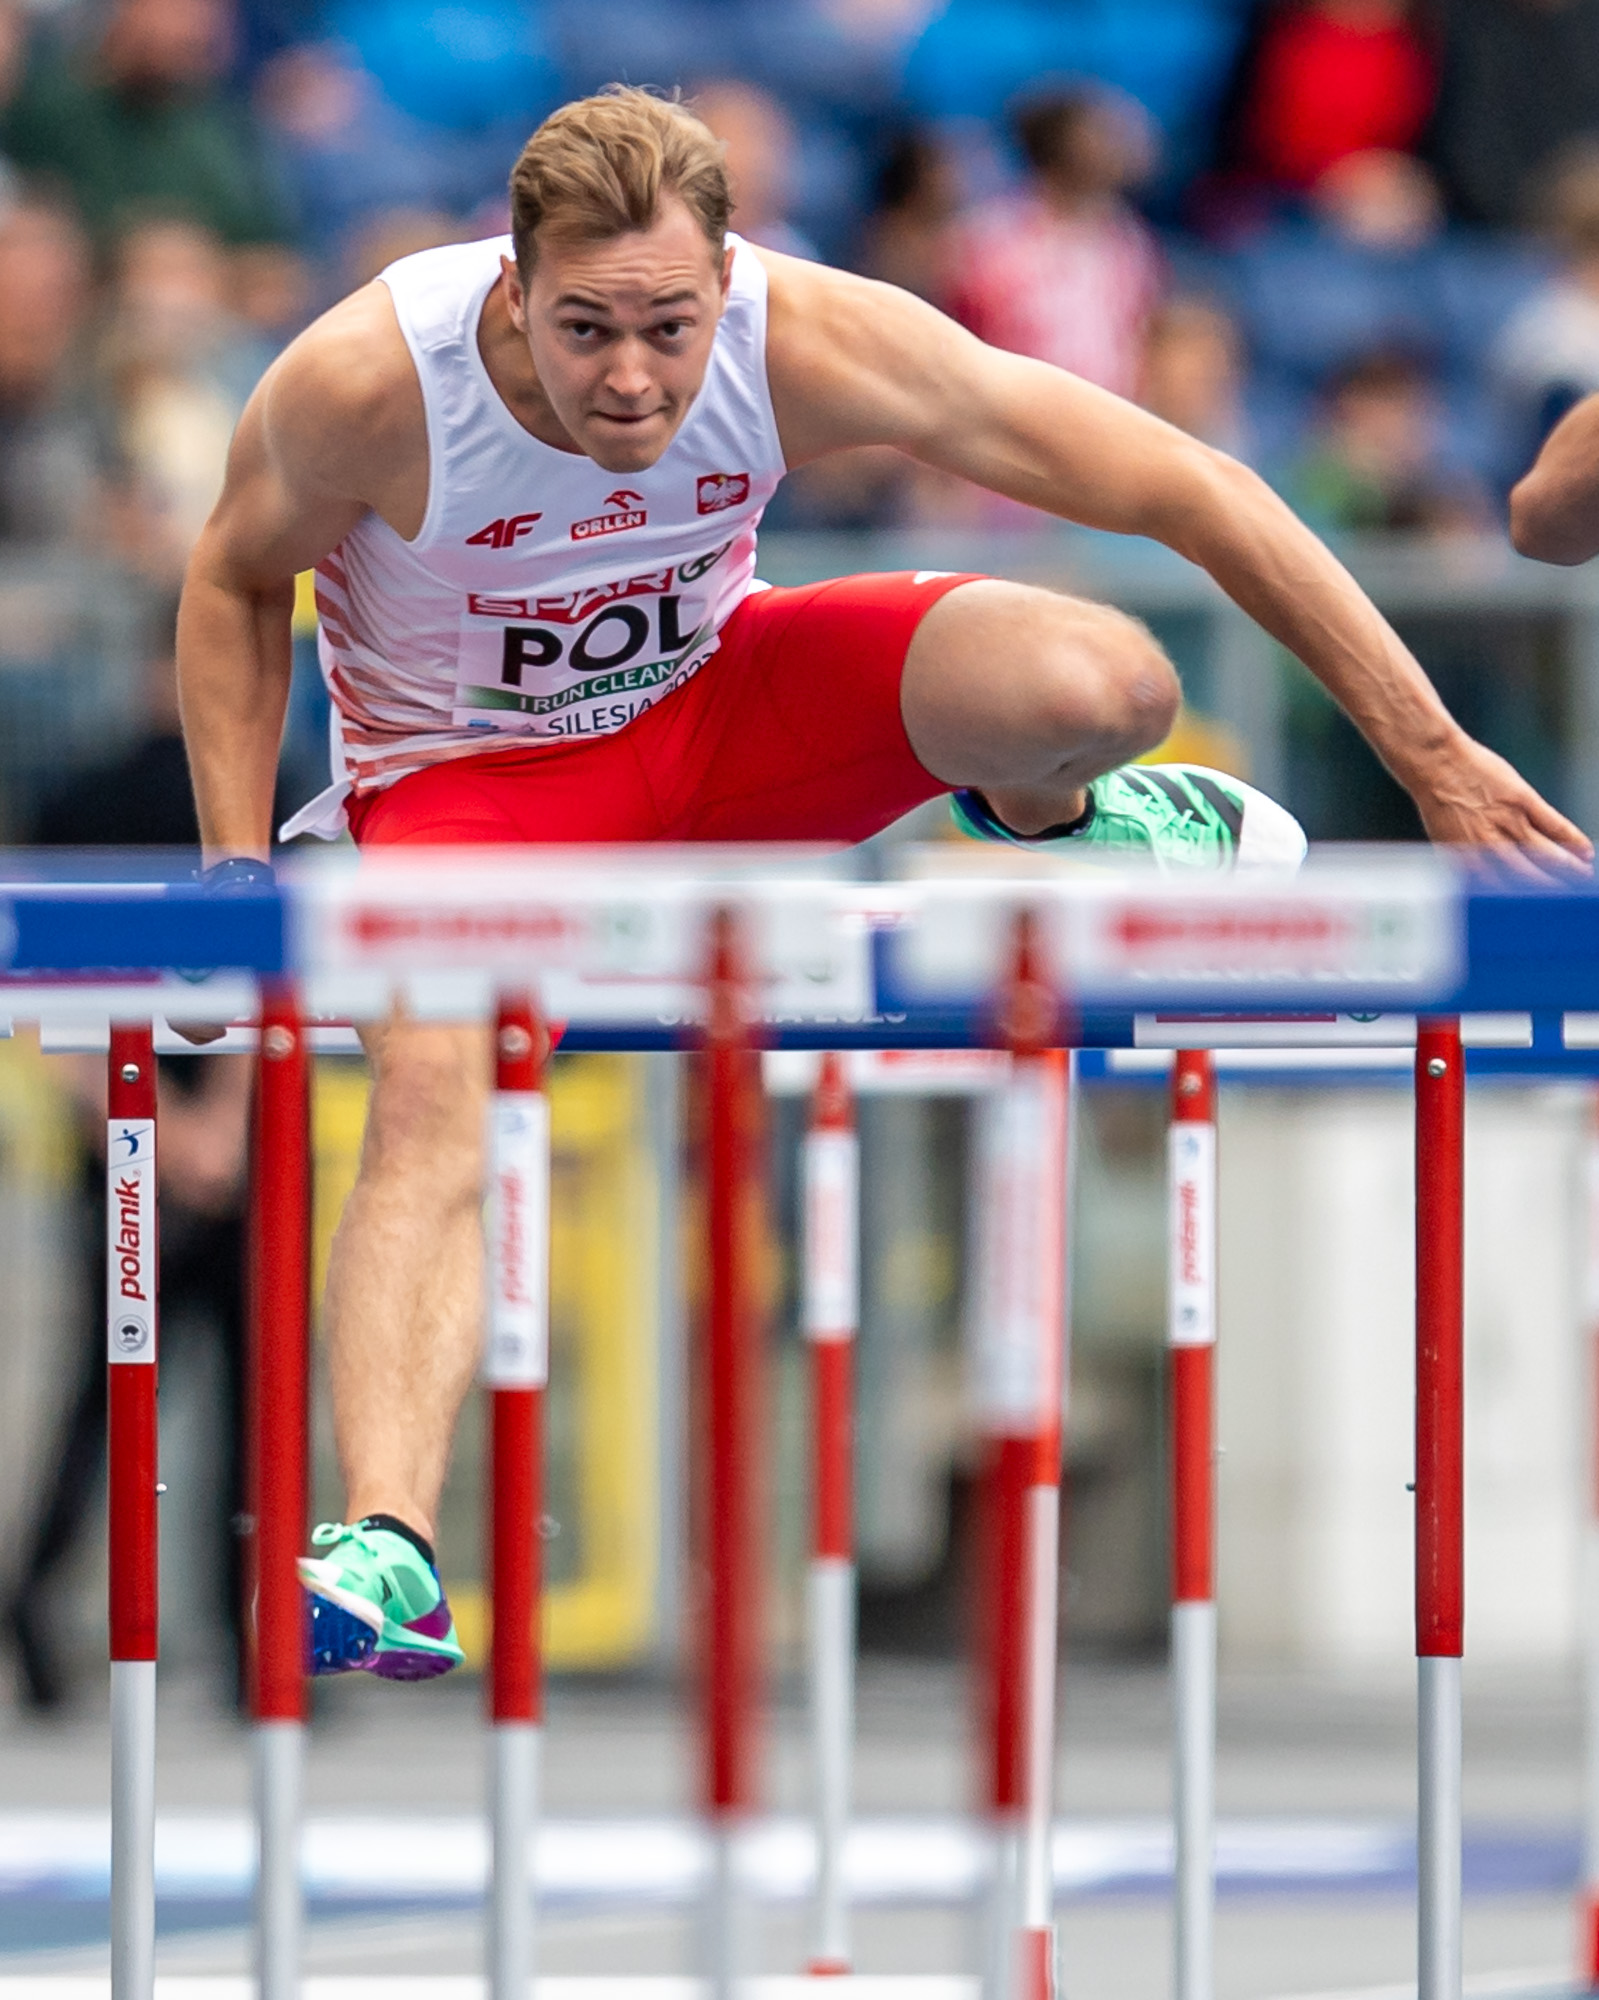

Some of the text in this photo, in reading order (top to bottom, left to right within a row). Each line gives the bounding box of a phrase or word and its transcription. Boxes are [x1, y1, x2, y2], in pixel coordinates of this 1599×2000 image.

[465, 512, 543, 549] 4F
[573, 512, 642, 537] ORLEN
[501, 595, 703, 687] POL
[520, 661, 675, 713] I RUN CLEAN
[547, 697, 653, 736] SILESIA
[114, 1176, 148, 1301] polanik
